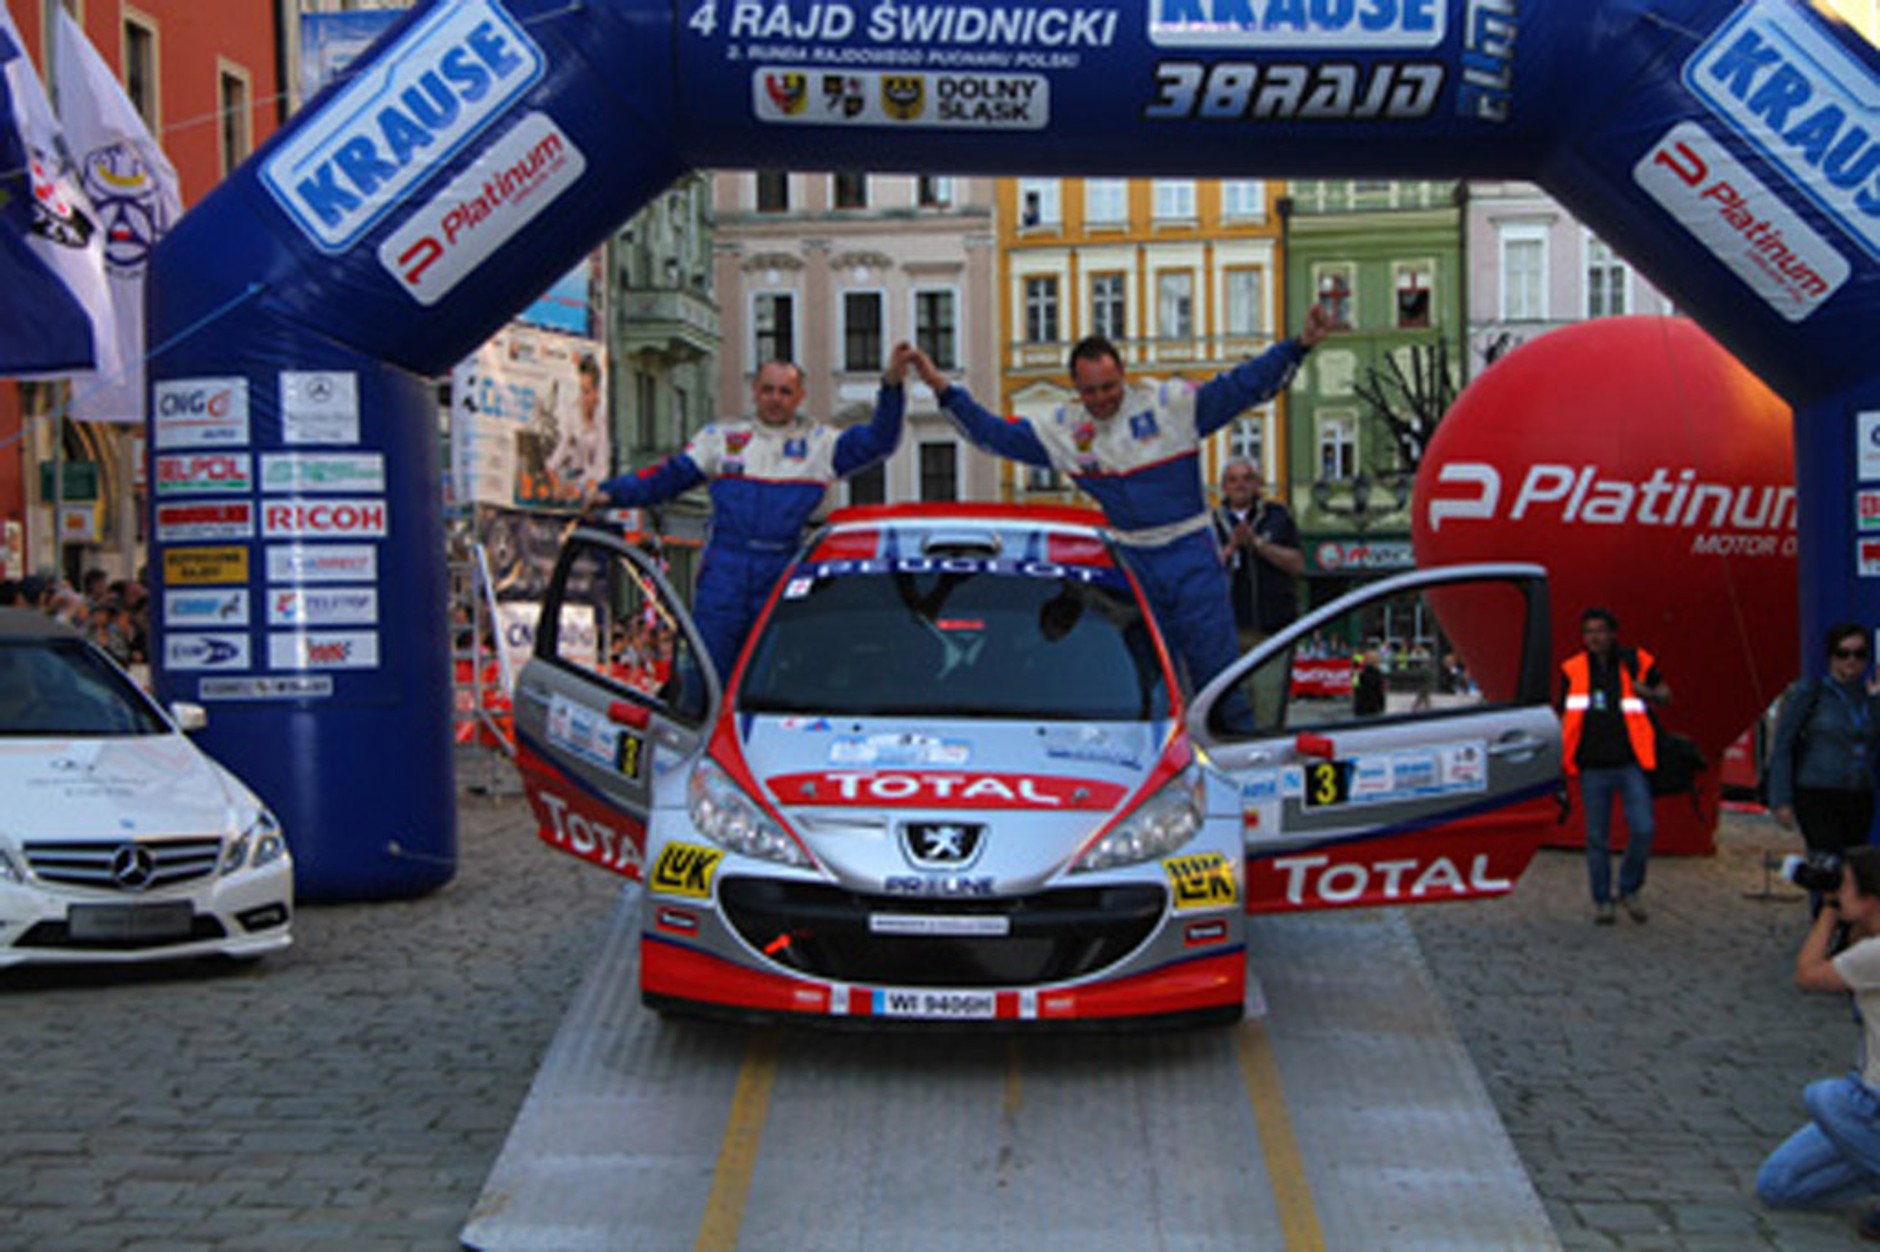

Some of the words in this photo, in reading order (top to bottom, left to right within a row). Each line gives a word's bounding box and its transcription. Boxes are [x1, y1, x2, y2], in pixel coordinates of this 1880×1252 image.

[689, 11, 716, 36] 4
[730, 3, 854, 40] RAJD
[868, 0, 1117, 46] ŚWIDNICKI
[937, 77, 1038, 101] DOLNY
[296, 21, 522, 229] KRAUSE
[441, 133, 565, 245] Platinum
[1702, 181, 1829, 297] Platinum
[266, 504, 384, 531] RICOH
[1690, 534, 1777, 554] MOTOR
[825, 773, 1061, 805] TOTAL
[1315, 763, 1338, 805] 3
[539, 791, 646, 879] TOTA
[1273, 854, 1511, 905] TOTAL
